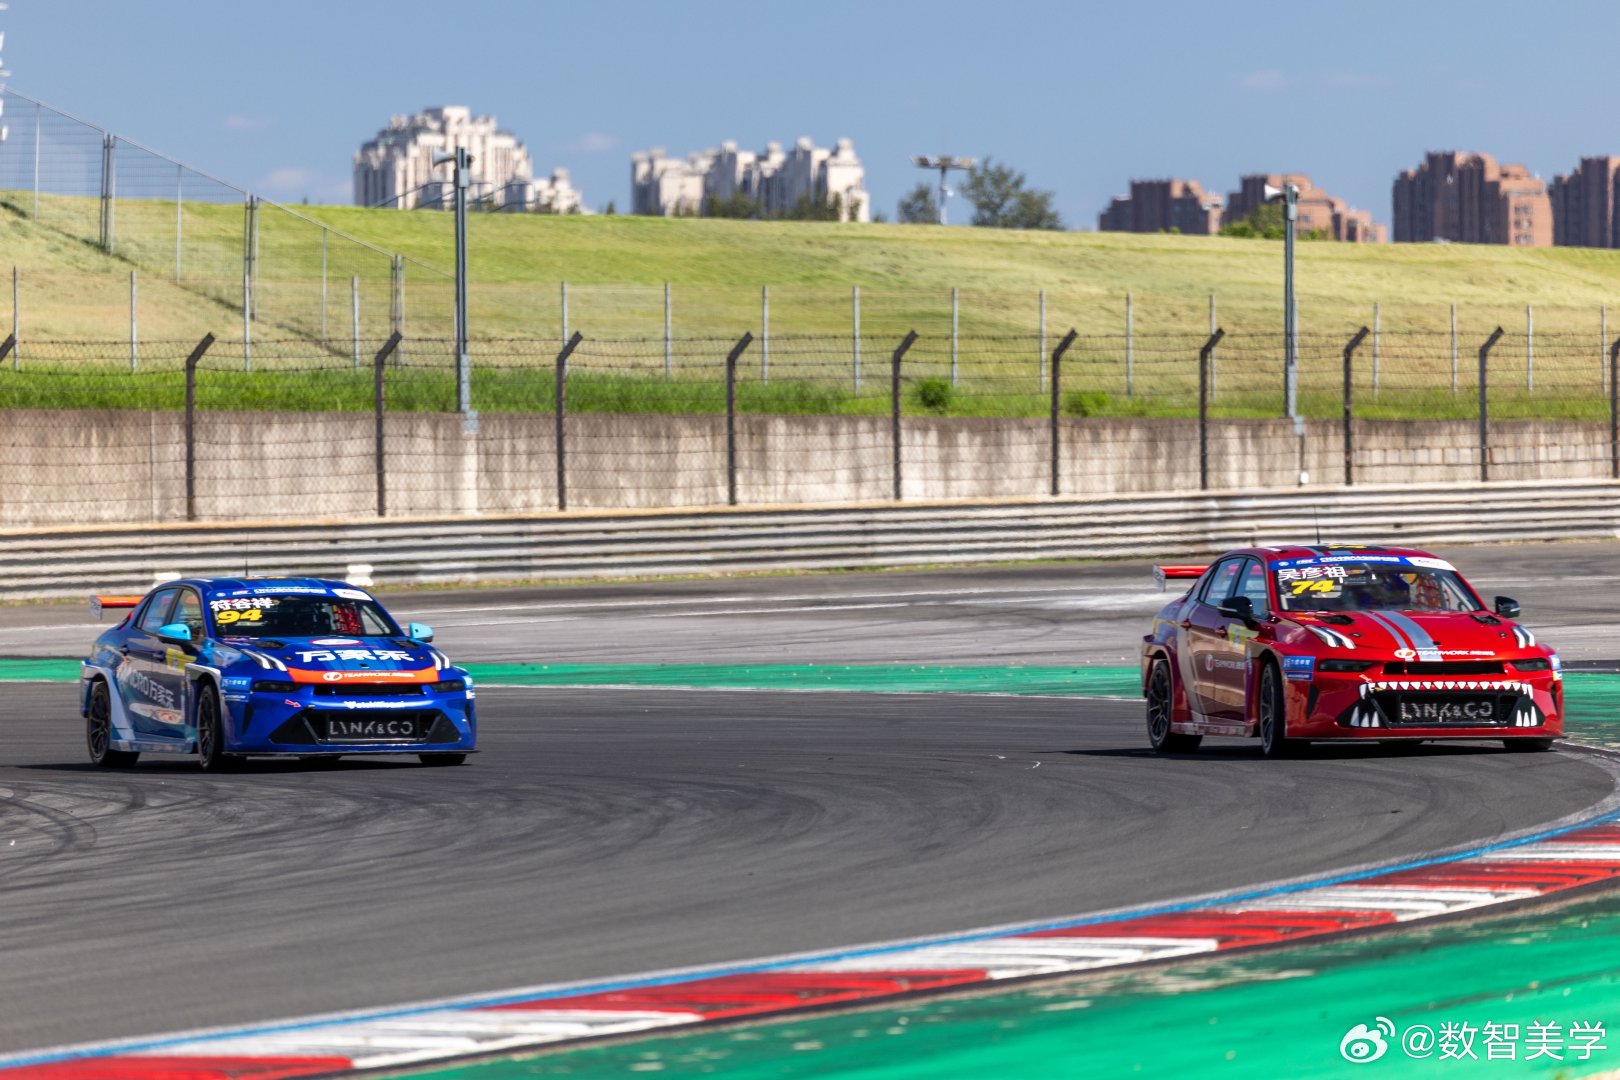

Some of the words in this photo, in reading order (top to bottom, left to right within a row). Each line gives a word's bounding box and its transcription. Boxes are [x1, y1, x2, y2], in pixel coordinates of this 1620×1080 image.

[1278, 566, 1348, 581] 吴彦祖
[1290, 580, 1335, 595] 74
[217, 609, 263, 624] 94
[295, 650, 415, 662] 万家乐
